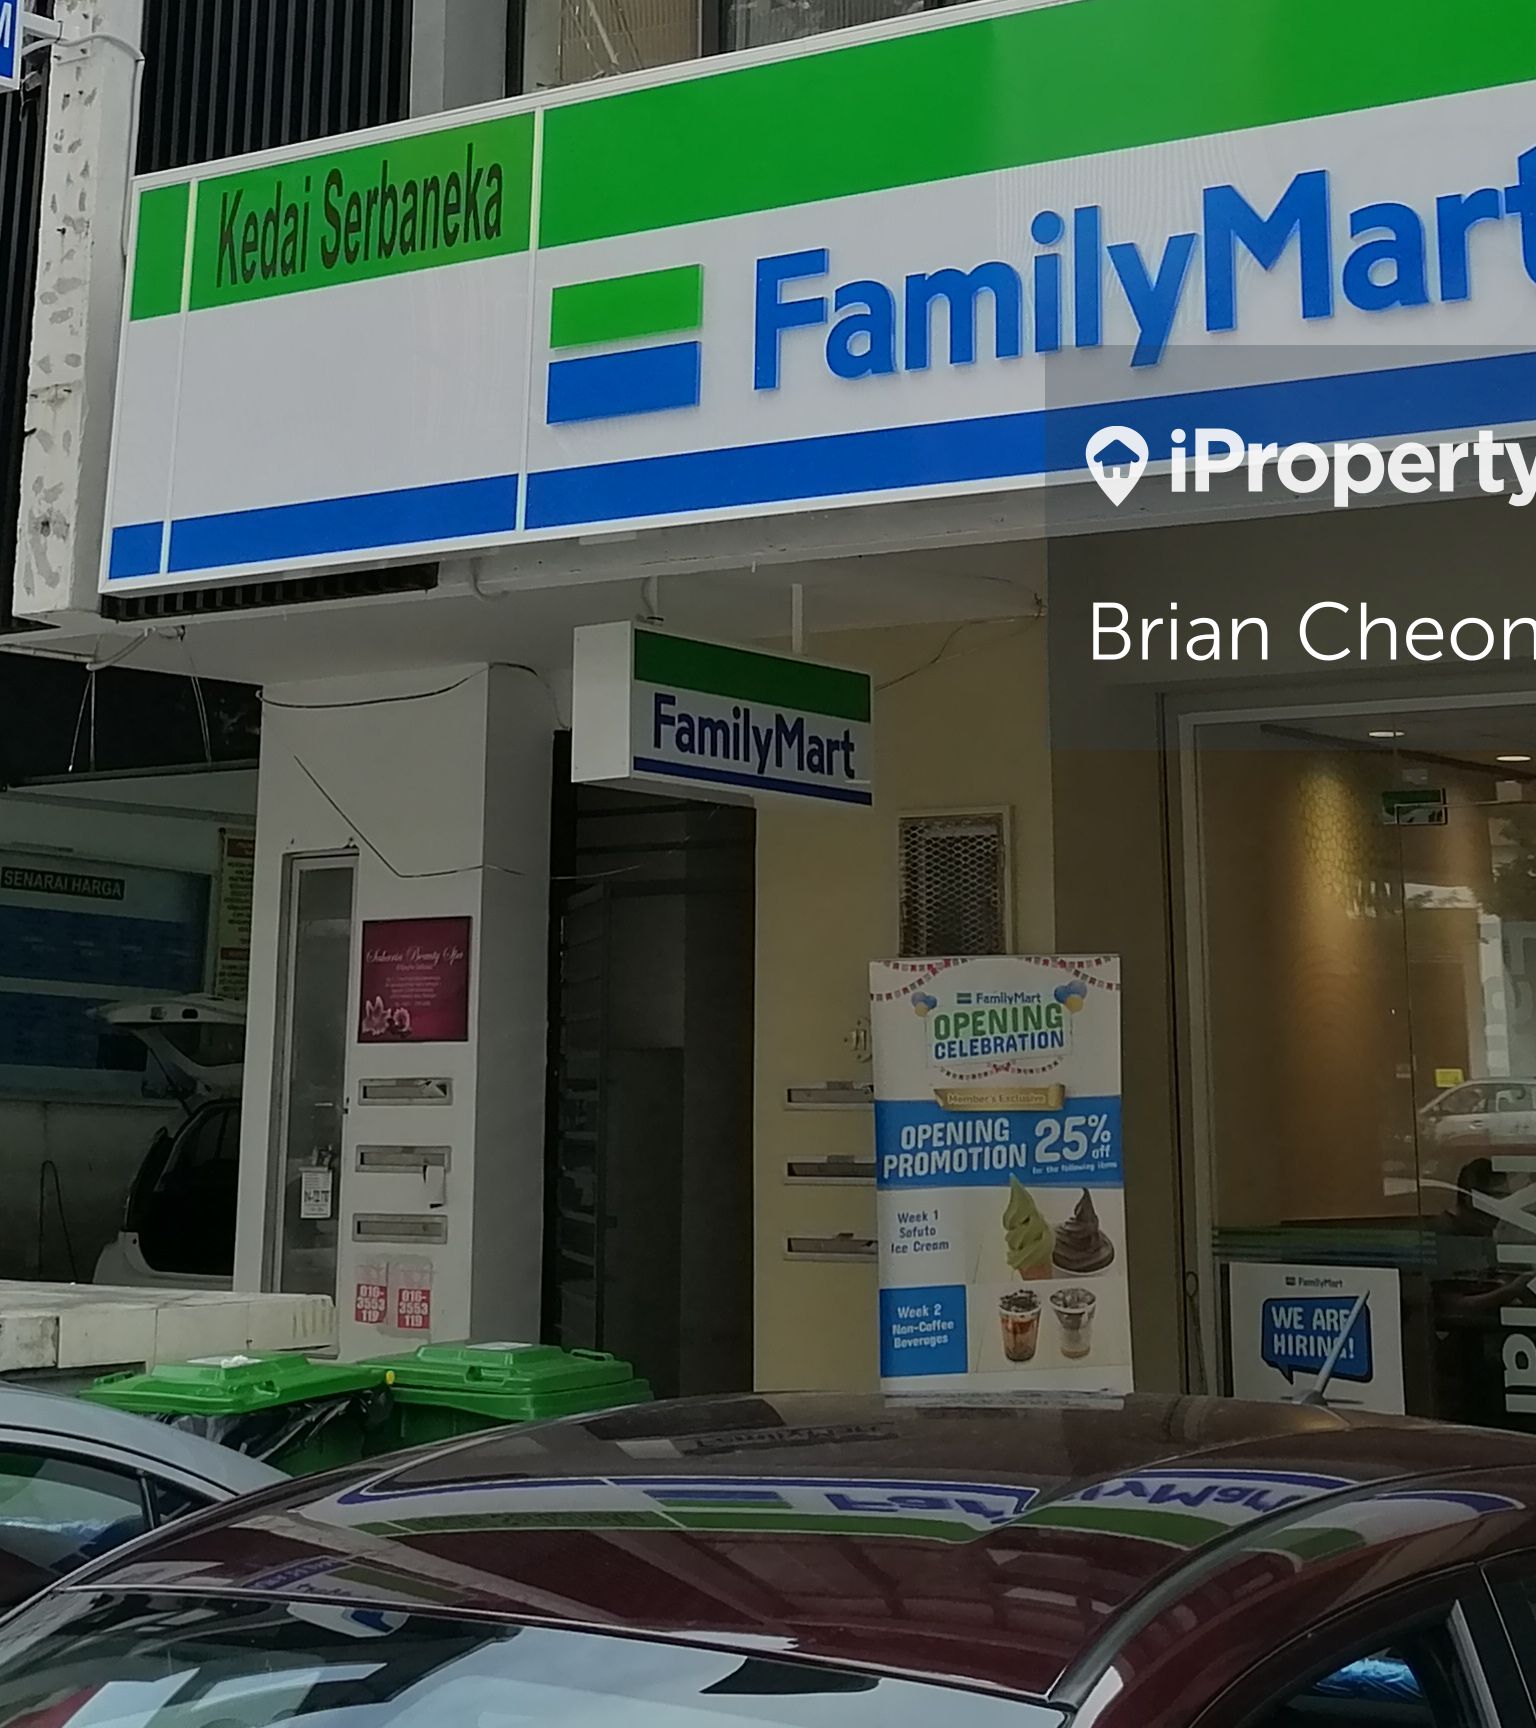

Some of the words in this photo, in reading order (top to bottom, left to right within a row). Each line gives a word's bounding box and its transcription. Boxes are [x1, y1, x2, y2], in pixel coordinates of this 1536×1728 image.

[216, 176, 312, 289] Kedai
[320, 142, 505, 271] Serbaneka
[653, 692, 855, 779] FamilyMart
[4, 869, 68, 894] SENARAI
[71, 877, 124, 900] HARGA
[975, 992, 1041, 1005] FamilyMart
[934, 1003, 1063, 1041] OPENING
[934, 1030, 1064, 1060] CELEBRATION
[901, 1117, 1010, 1150] OPENING
[1034, 1113, 1111, 1164] 25%
[1091, 1145, 1111, 1160] off
[883, 1143, 1026, 1180] PROMOTION
[897, 1211, 925, 1224] Week
[933, 1209, 939, 1221] 1
[899, 1225, 936, 1239] Sofuto
[891, 1242, 910, 1254] Ice
[913, 1239, 949, 1253] Cream
[357, 1297, 385, 1311] 3553
[399, 1302, 428, 1314] 3553
[897, 1305, 929, 1320] Week
[933, 1303, 942, 1317] 2
[362, 1310, 379, 1322] 119
[404, 1314, 423, 1327] 119
[1271, 1305, 1305, 1331] WE
[892, 1318, 955, 1336] Non-Coffee
[893, 1333, 949, 1350] Beverages
